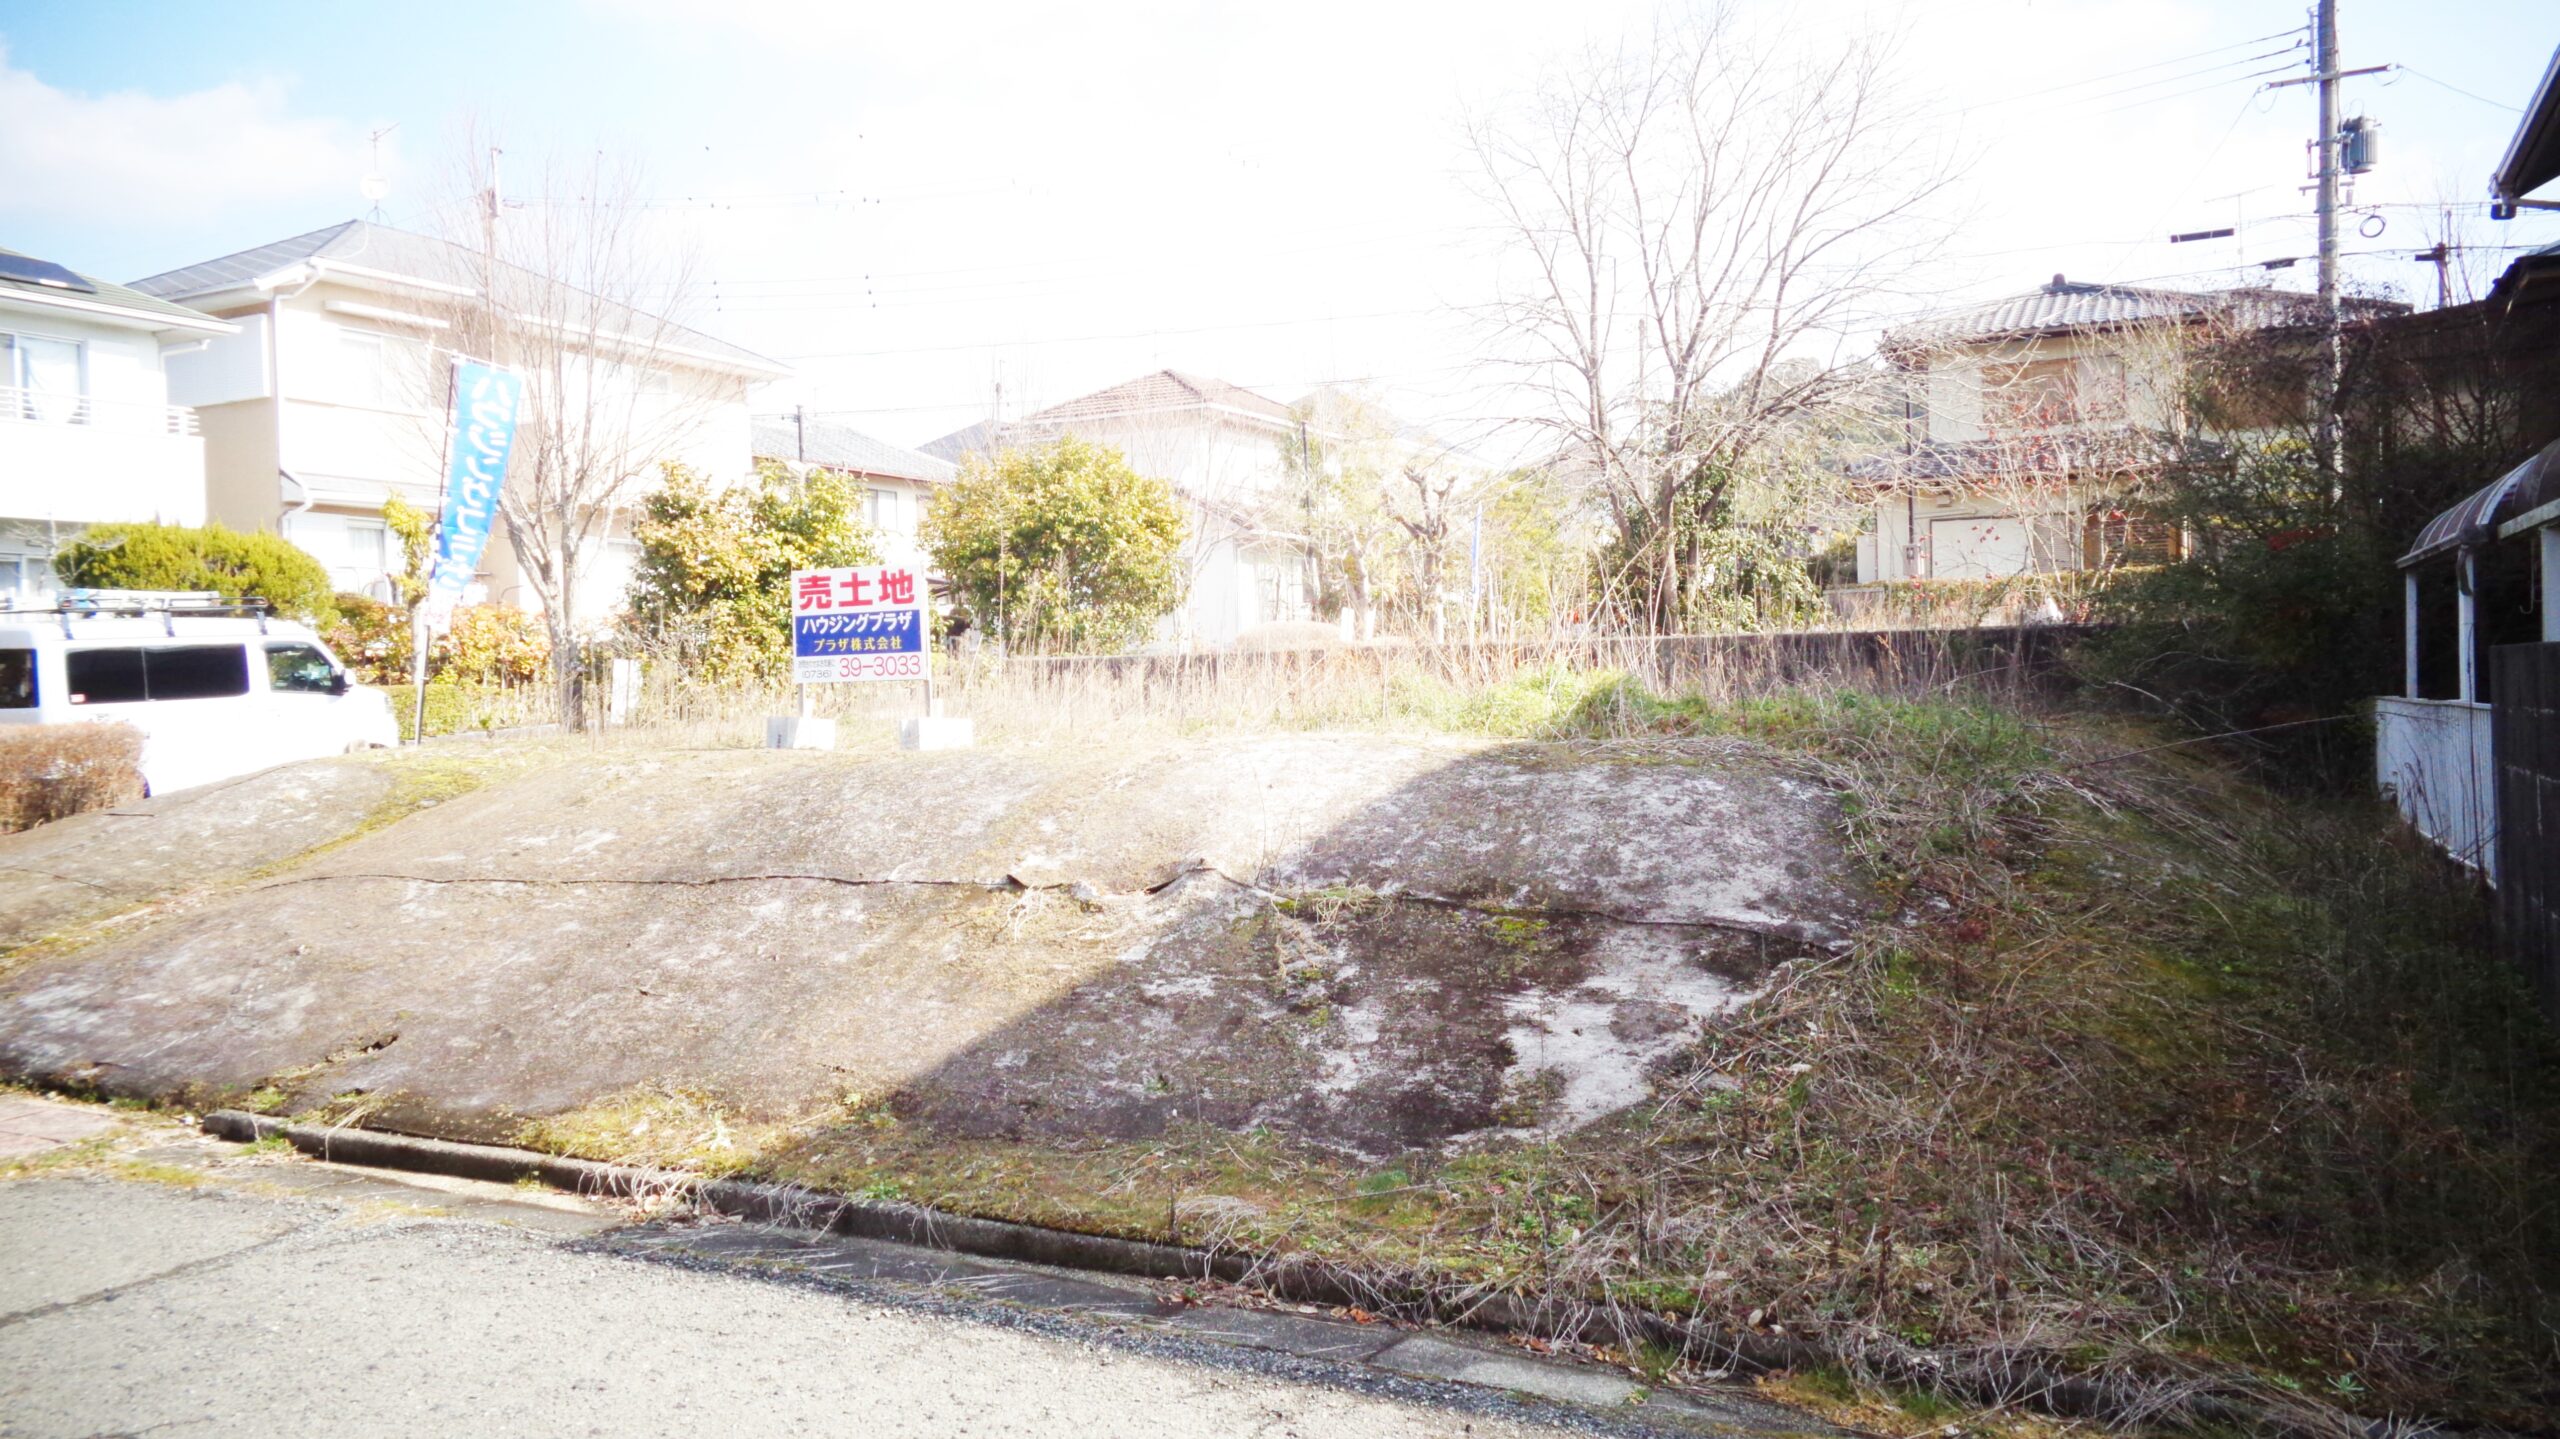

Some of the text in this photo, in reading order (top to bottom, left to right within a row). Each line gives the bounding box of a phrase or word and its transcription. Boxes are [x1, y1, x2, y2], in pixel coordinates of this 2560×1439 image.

[798, 568, 916, 611] 売土地
[801, 611, 913, 635] ハウジングプラザ
[813, 635, 903, 653] プラザ株式会社
[838, 654, 922, 678] 39-3033
